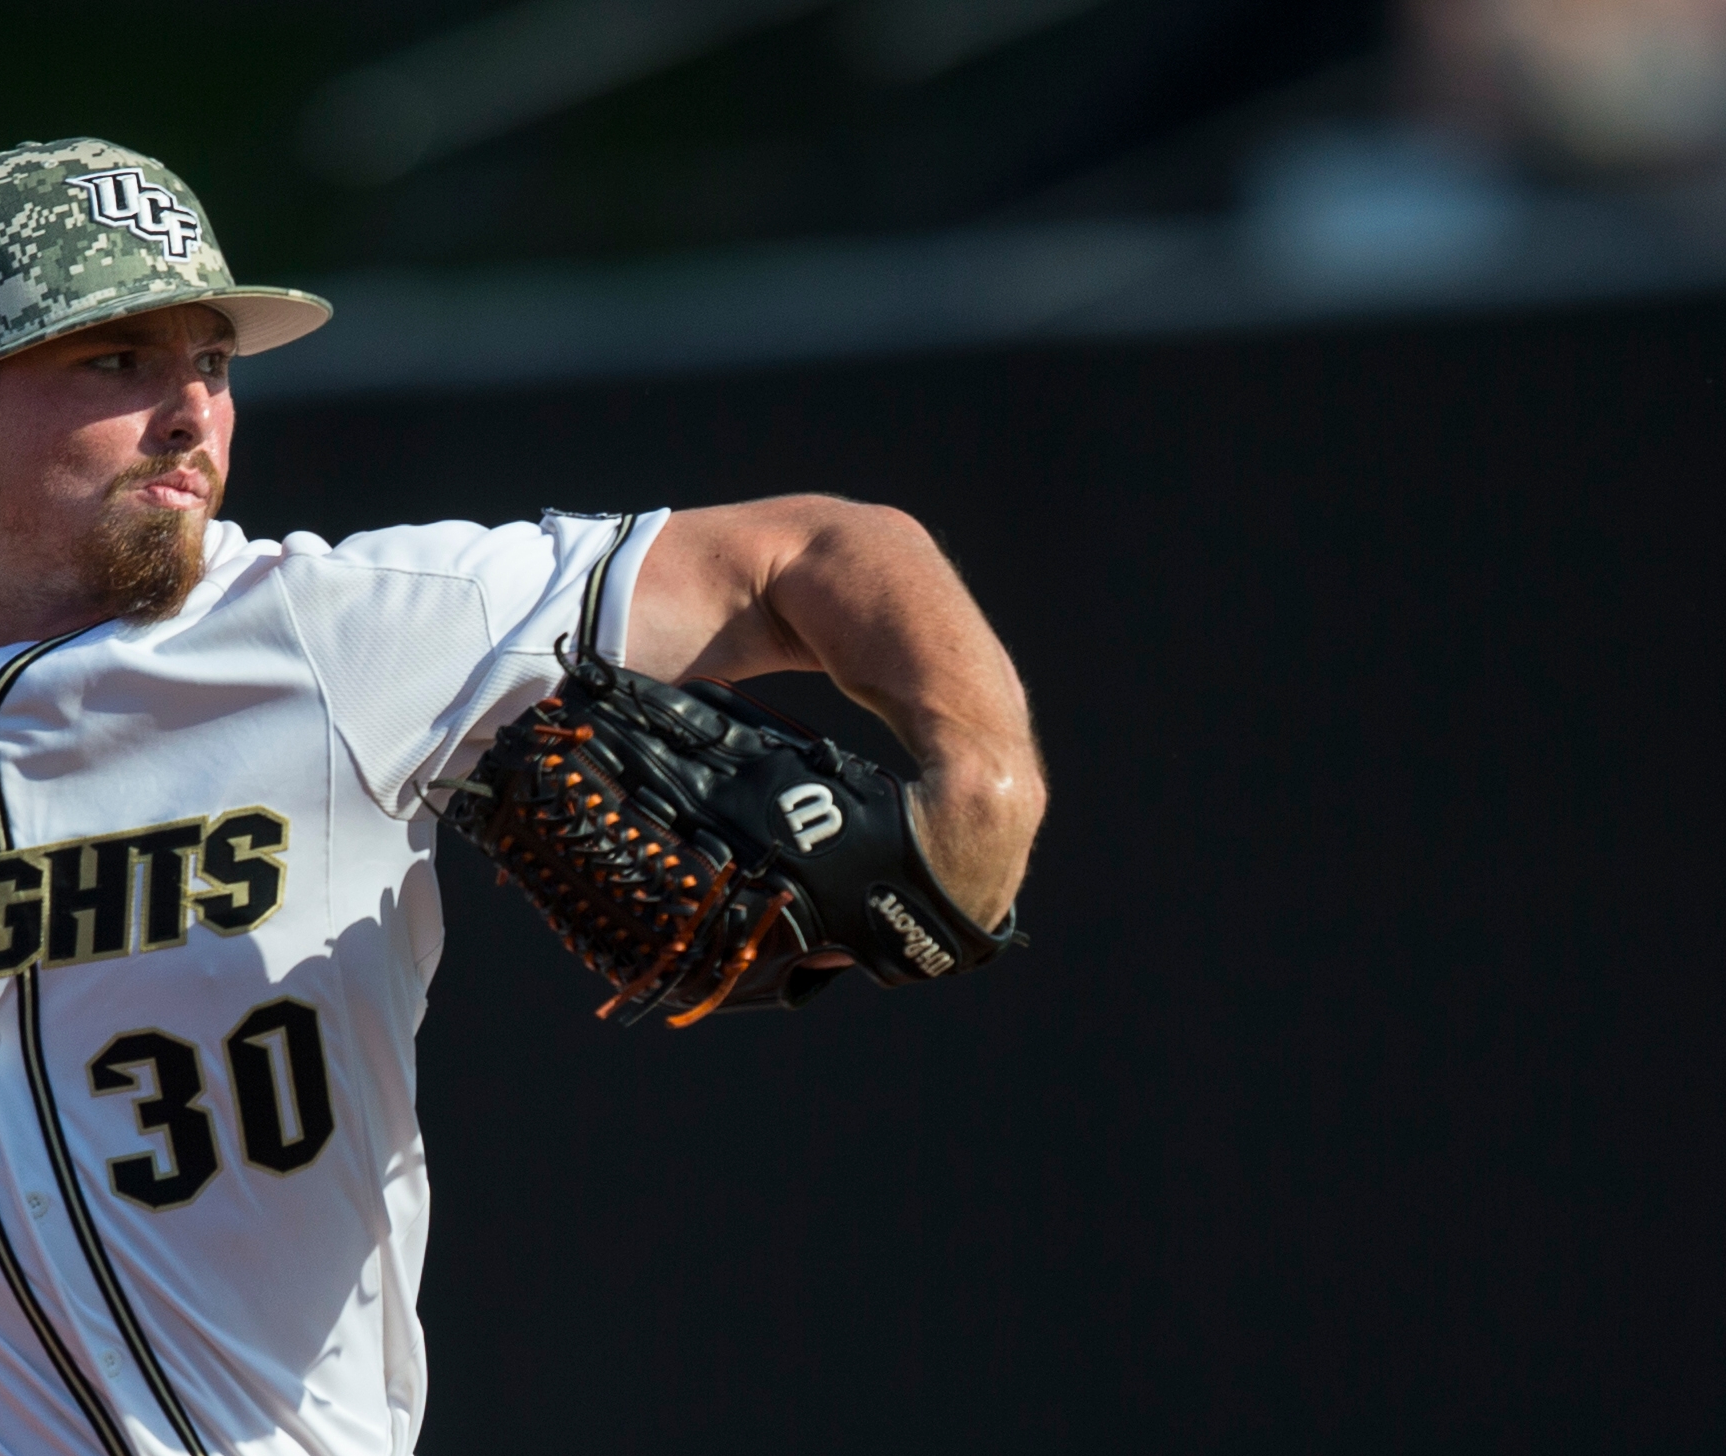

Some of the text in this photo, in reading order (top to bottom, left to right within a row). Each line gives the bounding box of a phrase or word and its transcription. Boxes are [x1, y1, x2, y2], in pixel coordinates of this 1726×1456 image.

[72, 168, 201, 263] UCF
[879, 892, 955, 977] Wilson
[86, 995, 335, 1212] 30
